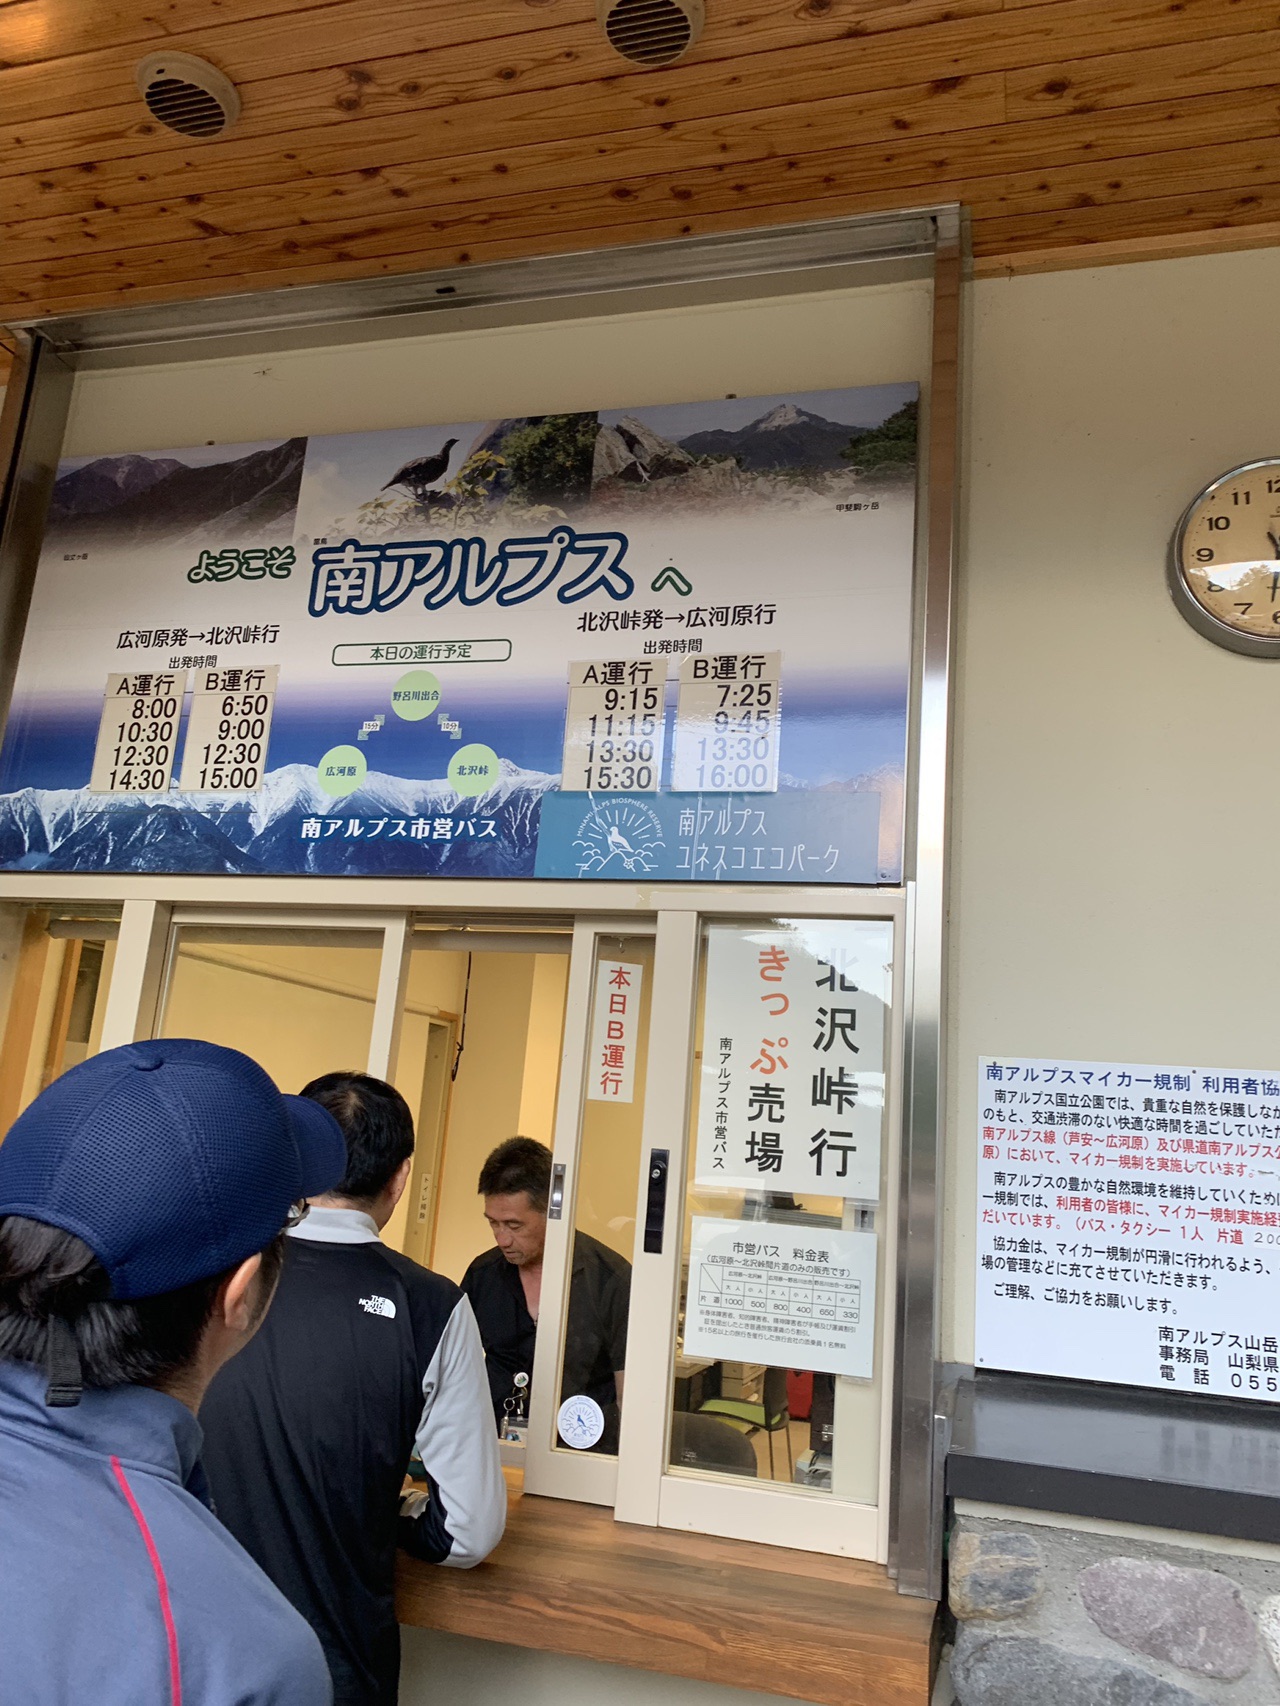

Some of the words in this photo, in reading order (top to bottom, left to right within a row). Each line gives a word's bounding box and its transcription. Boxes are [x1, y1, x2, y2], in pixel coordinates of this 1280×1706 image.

[1232, 491, 1250, 506] 11
[1206, 516, 1231, 531] 10
[1196, 547, 1214, 562] 9
[188, 545, 296, 583] ようこそ
[308, 525, 635, 618] 南アルプス
[1233, 602, 1254, 615] 7
[369, 643, 472, 661] 本日の運行予定
[643, 638, 703, 655] 出発時間
[168, 654, 217, 669] 出発時間
[693, 655, 767, 679] B運行
[205, 669, 266, 691] B運行
[582, 661, 654, 685] A運行
[116, 673, 175, 696] A運行
[717, 683, 772, 708] 7:25
[222, 694, 269, 716] 6:50
[392, 690, 441, 702] 野呂川出合
[604, 687, 659, 711] 9:15
[131, 697, 177, 719] 8:00
[117, 721, 173, 743] 10:30
[217, 718, 265, 740] 9:00
[588, 713, 656, 737] 11:15
[714, 710, 771, 734] 9:45
[113, 745, 169, 766] 12:30
[202, 743, 262, 765] 12:30
[586, 739, 654, 763] 13:30
[697, 736, 770, 761] 13:30
[109, 769, 165, 790] 14:30
[199, 767, 258, 789] 15:00
[324, 765, 358, 777] 広河原
[456, 764, 489, 776] 北沢峠
[583, 765, 652, 790] 15:30
[696, 763, 769, 788] 16:00
[300, 816, 498, 840] 南アルプス市営バス
[611, 797, 649, 812] BIOSPHERE
[647, 809, 663, 838] RESERVE
[678, 808, 767, 837] 南アルプス
[675, 843, 840, 873] ユネスコエコパーク
[599, 966, 632, 1097] 本日B運行
[744, 945, 790, 1173] きっぷ売場
[808, 948, 860, 1178] 北沢峠行
[986, 1064, 1191, 1092] 南アルプスマイカー規制
[712, 1037, 733, 1170] 南アルプス市営バス
[732, 1241, 780, 1258] 市営バス
[792, 1247, 830, 1264] 料金表
[981, 1254, 1219, 1291] 場の管理などに充てさせていただきます。
[724, 1298, 743, 1306] 1000
[750, 1301, 766, 1309] 500
[773, 1303, 788, 1311] 800
[993, 1282, 1178, 1315] ご理解、ご協力をお願いします。
[796, 1306, 812, 1314] 400
[819, 1308, 835, 1317] 650
[842, 1311, 859, 1319] 330
[1158, 1325, 1279, 1354] 南アルプス山岳
[1158, 1345, 1210, 1366] 事務局
[1228, 1352, 1280, 1373] 山梨県
[1231, 1372, 1278, 1392] 055
